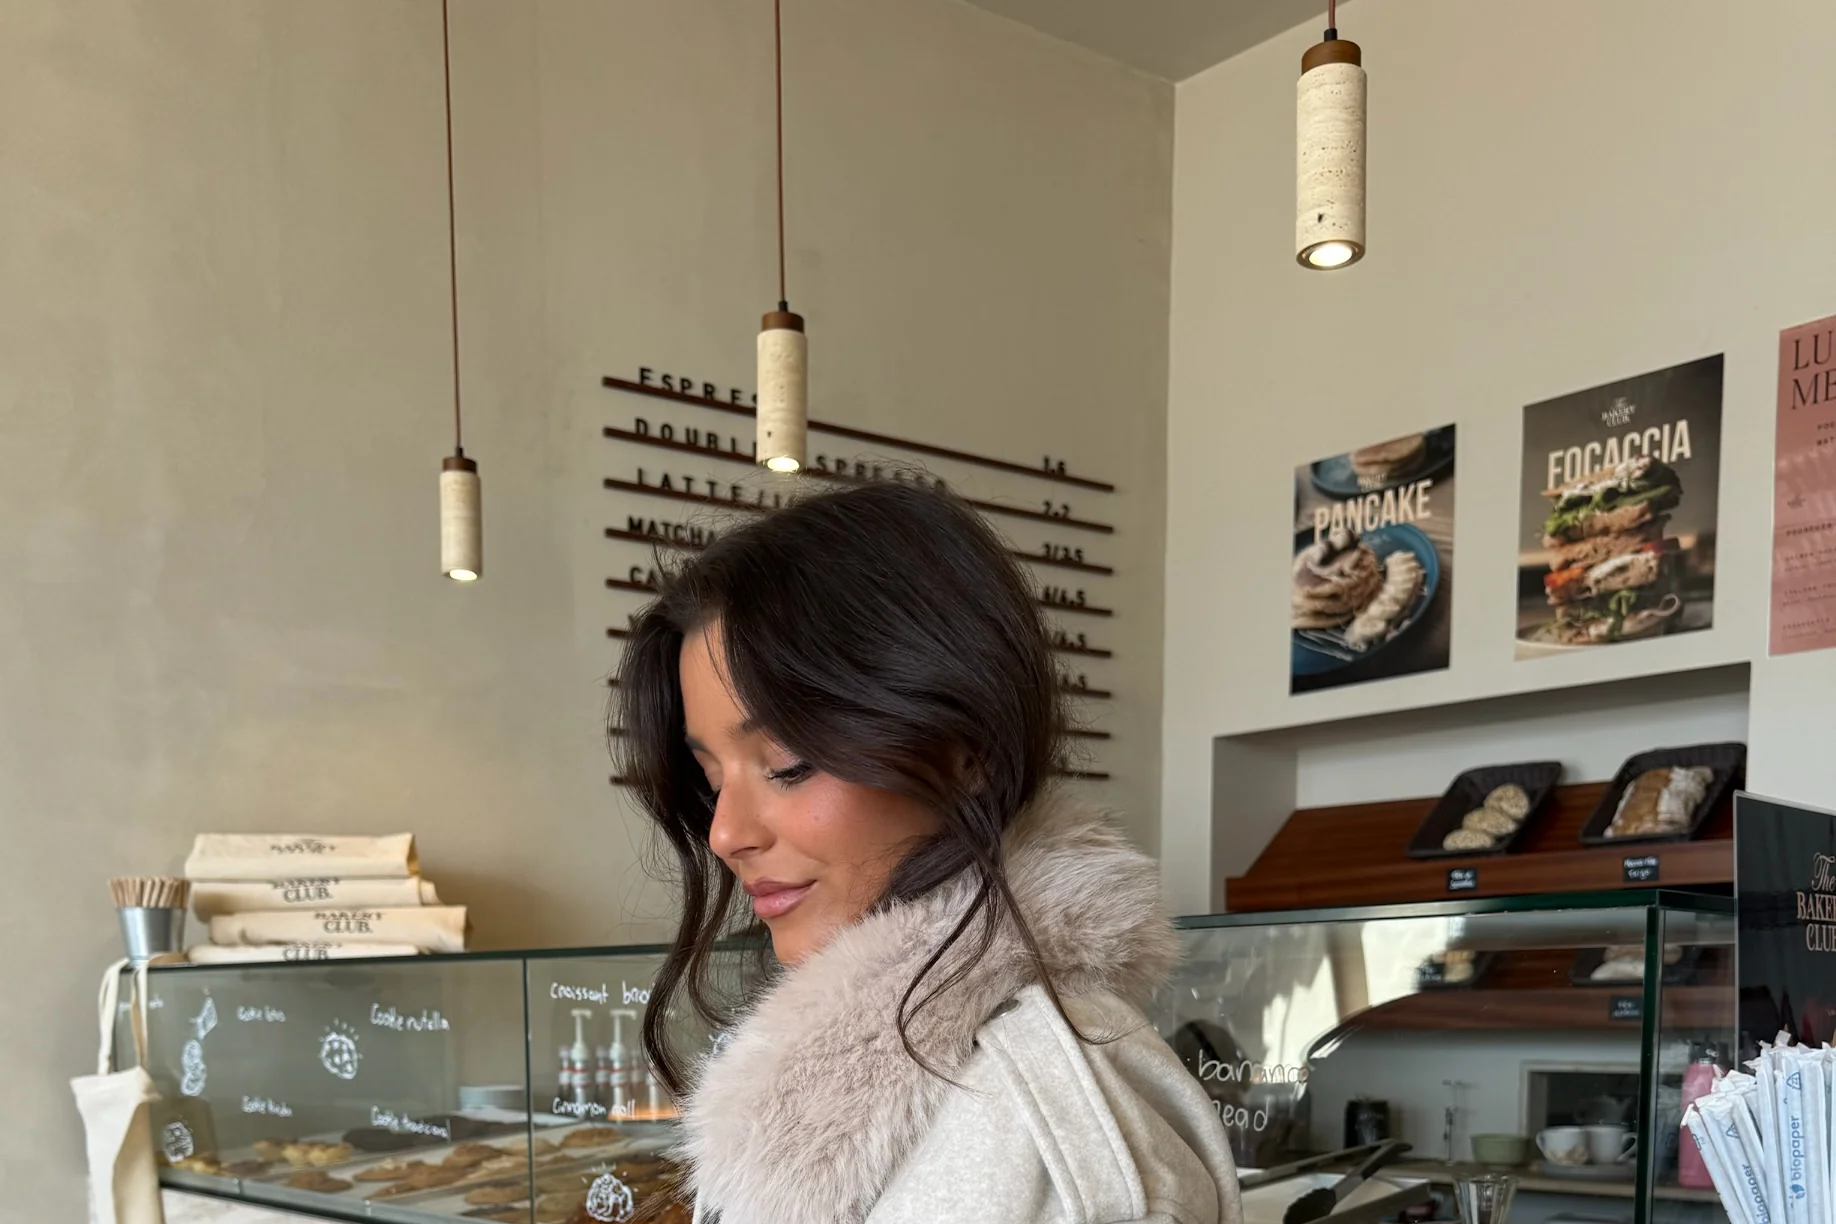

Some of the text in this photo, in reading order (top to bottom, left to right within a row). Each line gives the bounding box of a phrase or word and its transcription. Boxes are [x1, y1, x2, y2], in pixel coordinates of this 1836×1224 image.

[1547, 418, 1692, 491] FOCACCIA
[1313, 479, 1434, 545] PANCAKE
[1791, 1115, 1805, 1181] biopaper
